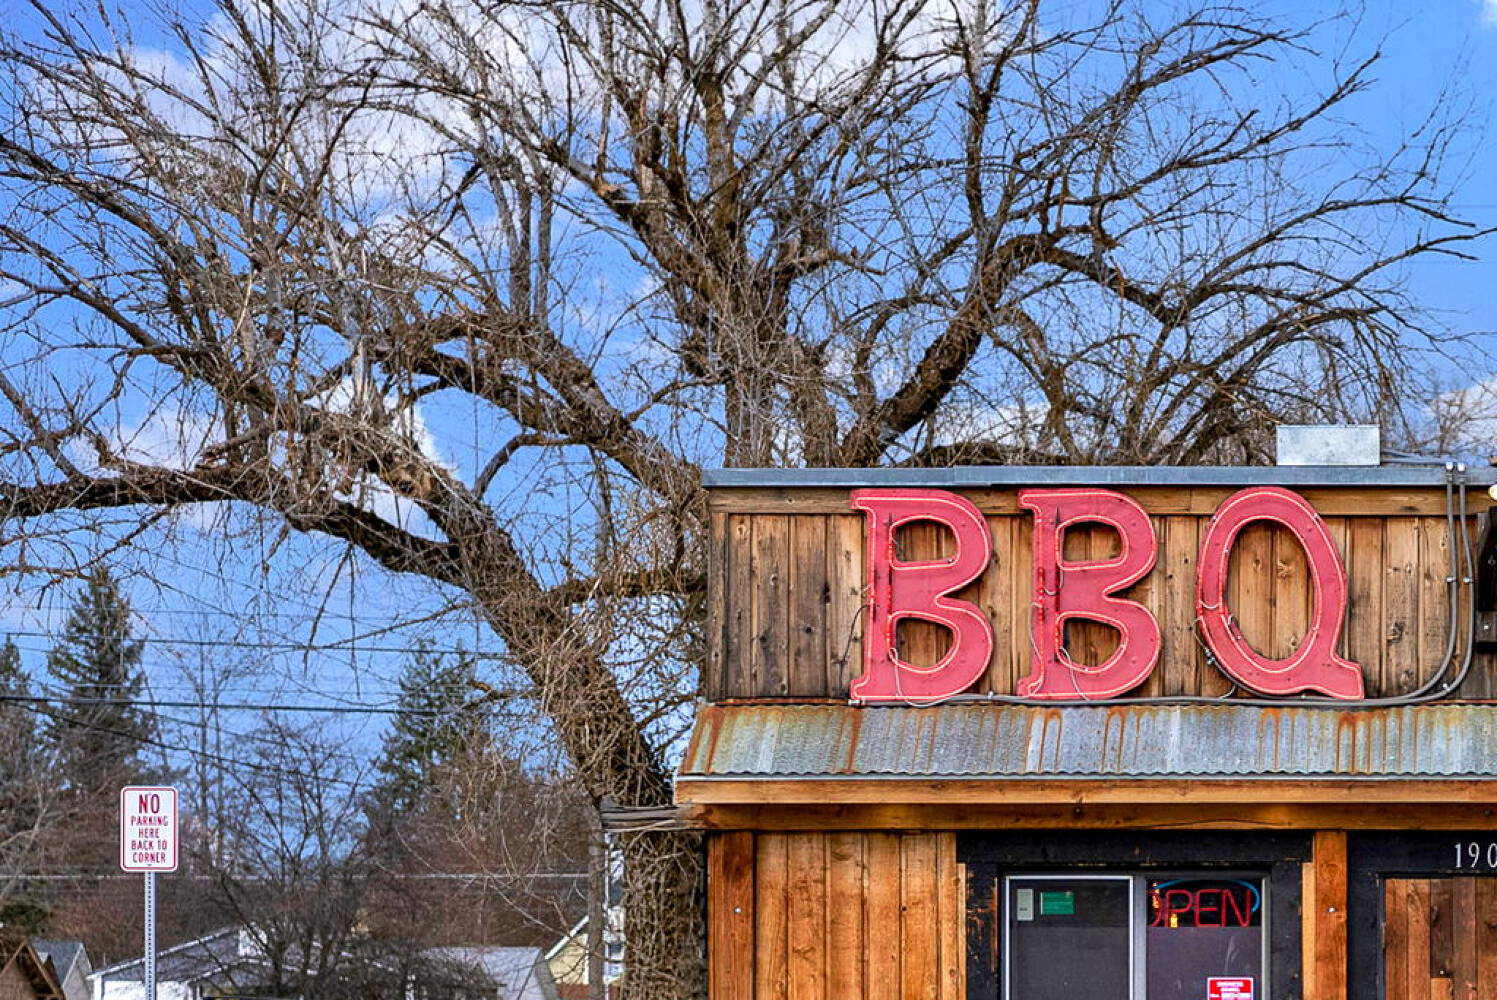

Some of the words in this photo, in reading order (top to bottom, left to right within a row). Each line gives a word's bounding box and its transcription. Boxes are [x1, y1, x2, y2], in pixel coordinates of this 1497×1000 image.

[850, 487, 1364, 701] BBQ
[138, 793, 160, 814] NO
[130, 816, 168, 827] PARKING
[138, 828, 160, 839] HERE
[131, 840, 154, 851] BACK
[157, 840, 168, 851] TO
[132, 852, 166, 863] CORNER
